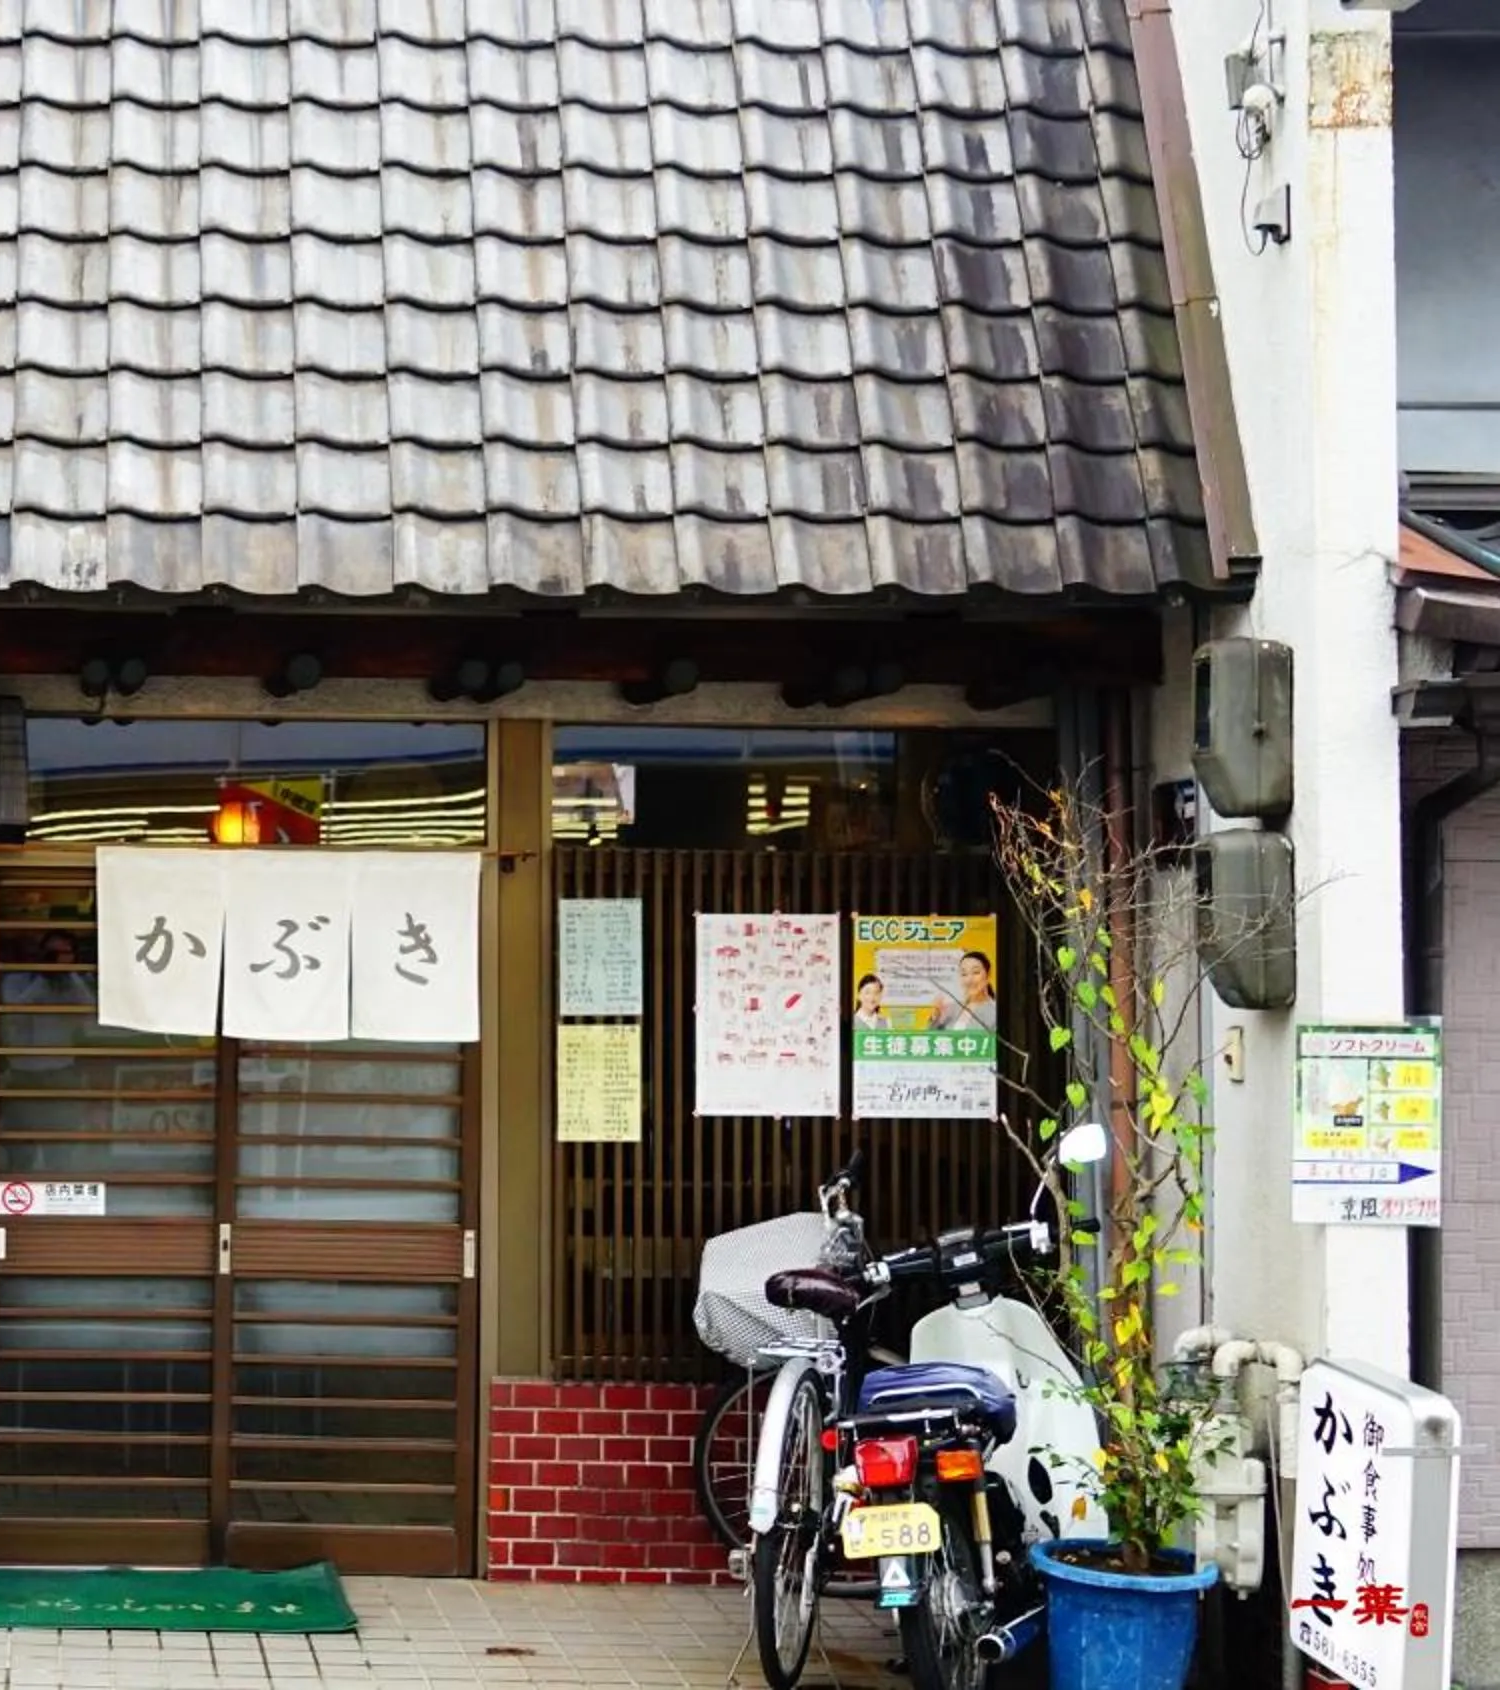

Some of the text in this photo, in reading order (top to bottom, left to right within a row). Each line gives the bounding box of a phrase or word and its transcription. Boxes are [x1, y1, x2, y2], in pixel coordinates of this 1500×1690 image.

[135, 912, 438, 985] かぶき
[1330, 1039, 1426, 1054] ソフトクリーム
[1308, 1391, 1354, 1627] かぶき
[1357, 1409, 1385, 1586] 御食事処
